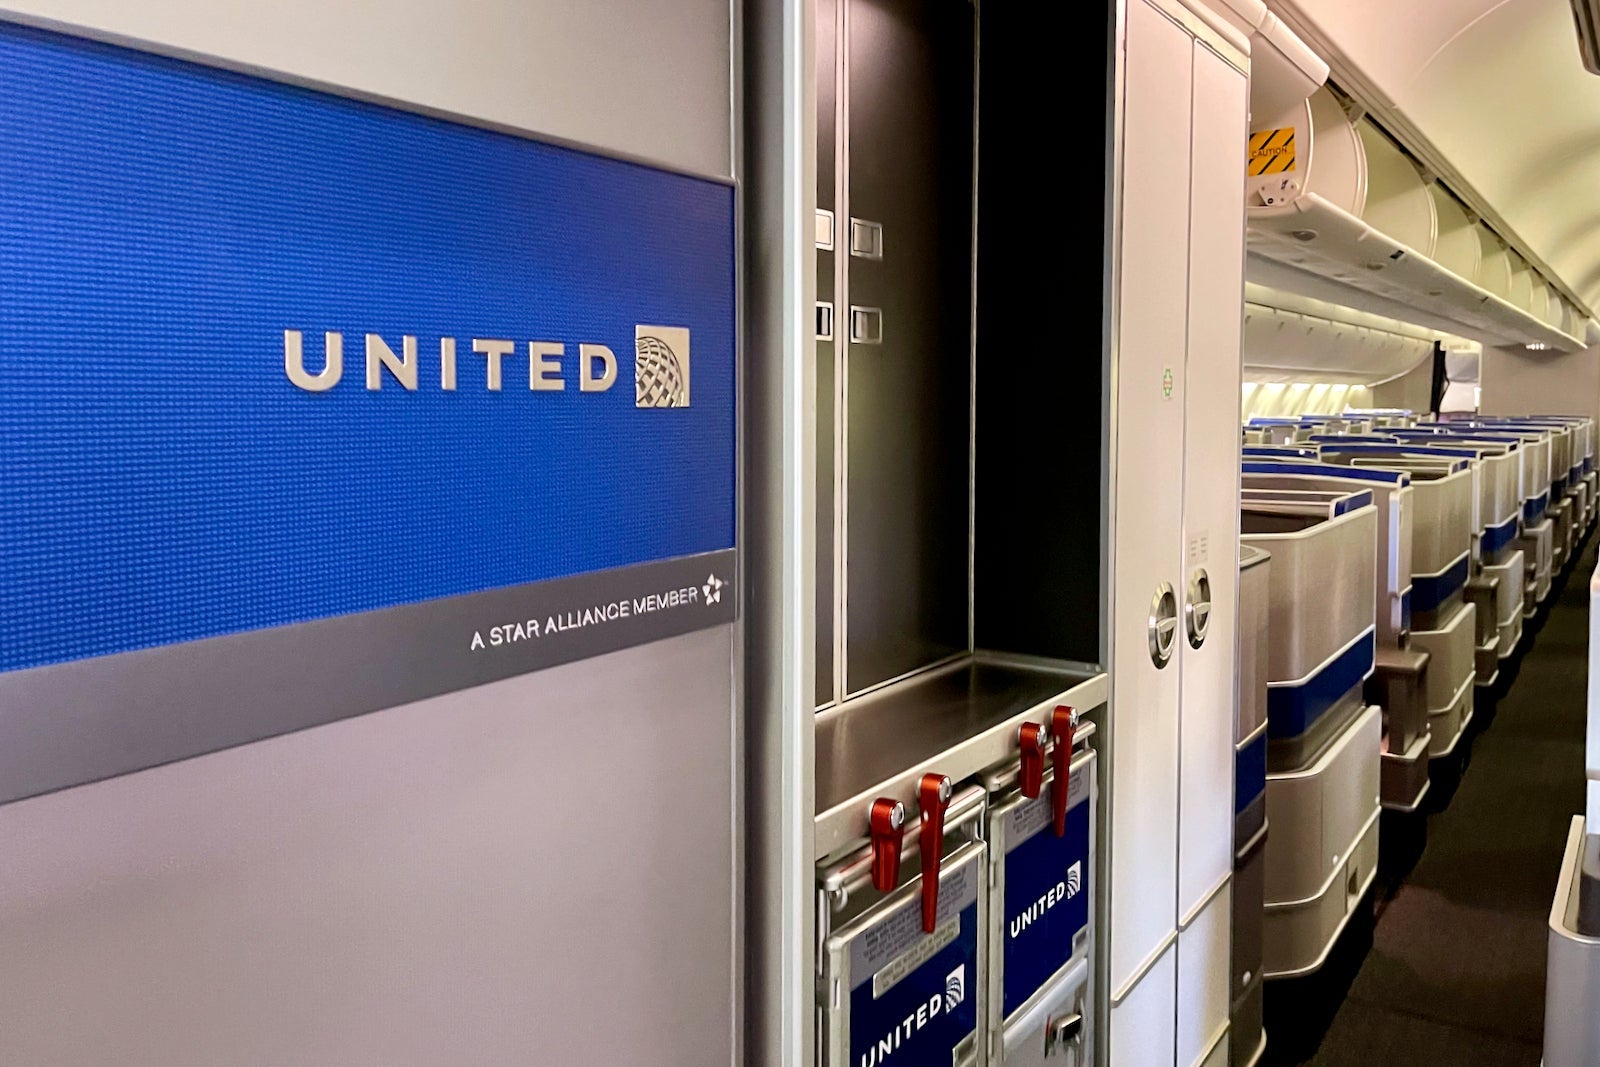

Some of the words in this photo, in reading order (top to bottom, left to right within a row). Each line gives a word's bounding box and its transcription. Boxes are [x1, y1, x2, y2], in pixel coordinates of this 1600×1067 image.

[1252, 147, 1287, 158] CAUTION
[284, 330, 617, 393] UNITED
[470, 631, 485, 651] A
[489, 619, 540, 647] STAR
[544, 600, 630, 635] ALLIANCE
[633, 586, 698, 615] MEMBER
[1011, 882, 1065, 938] UNITED
[862, 994, 941, 1067] UNITED
